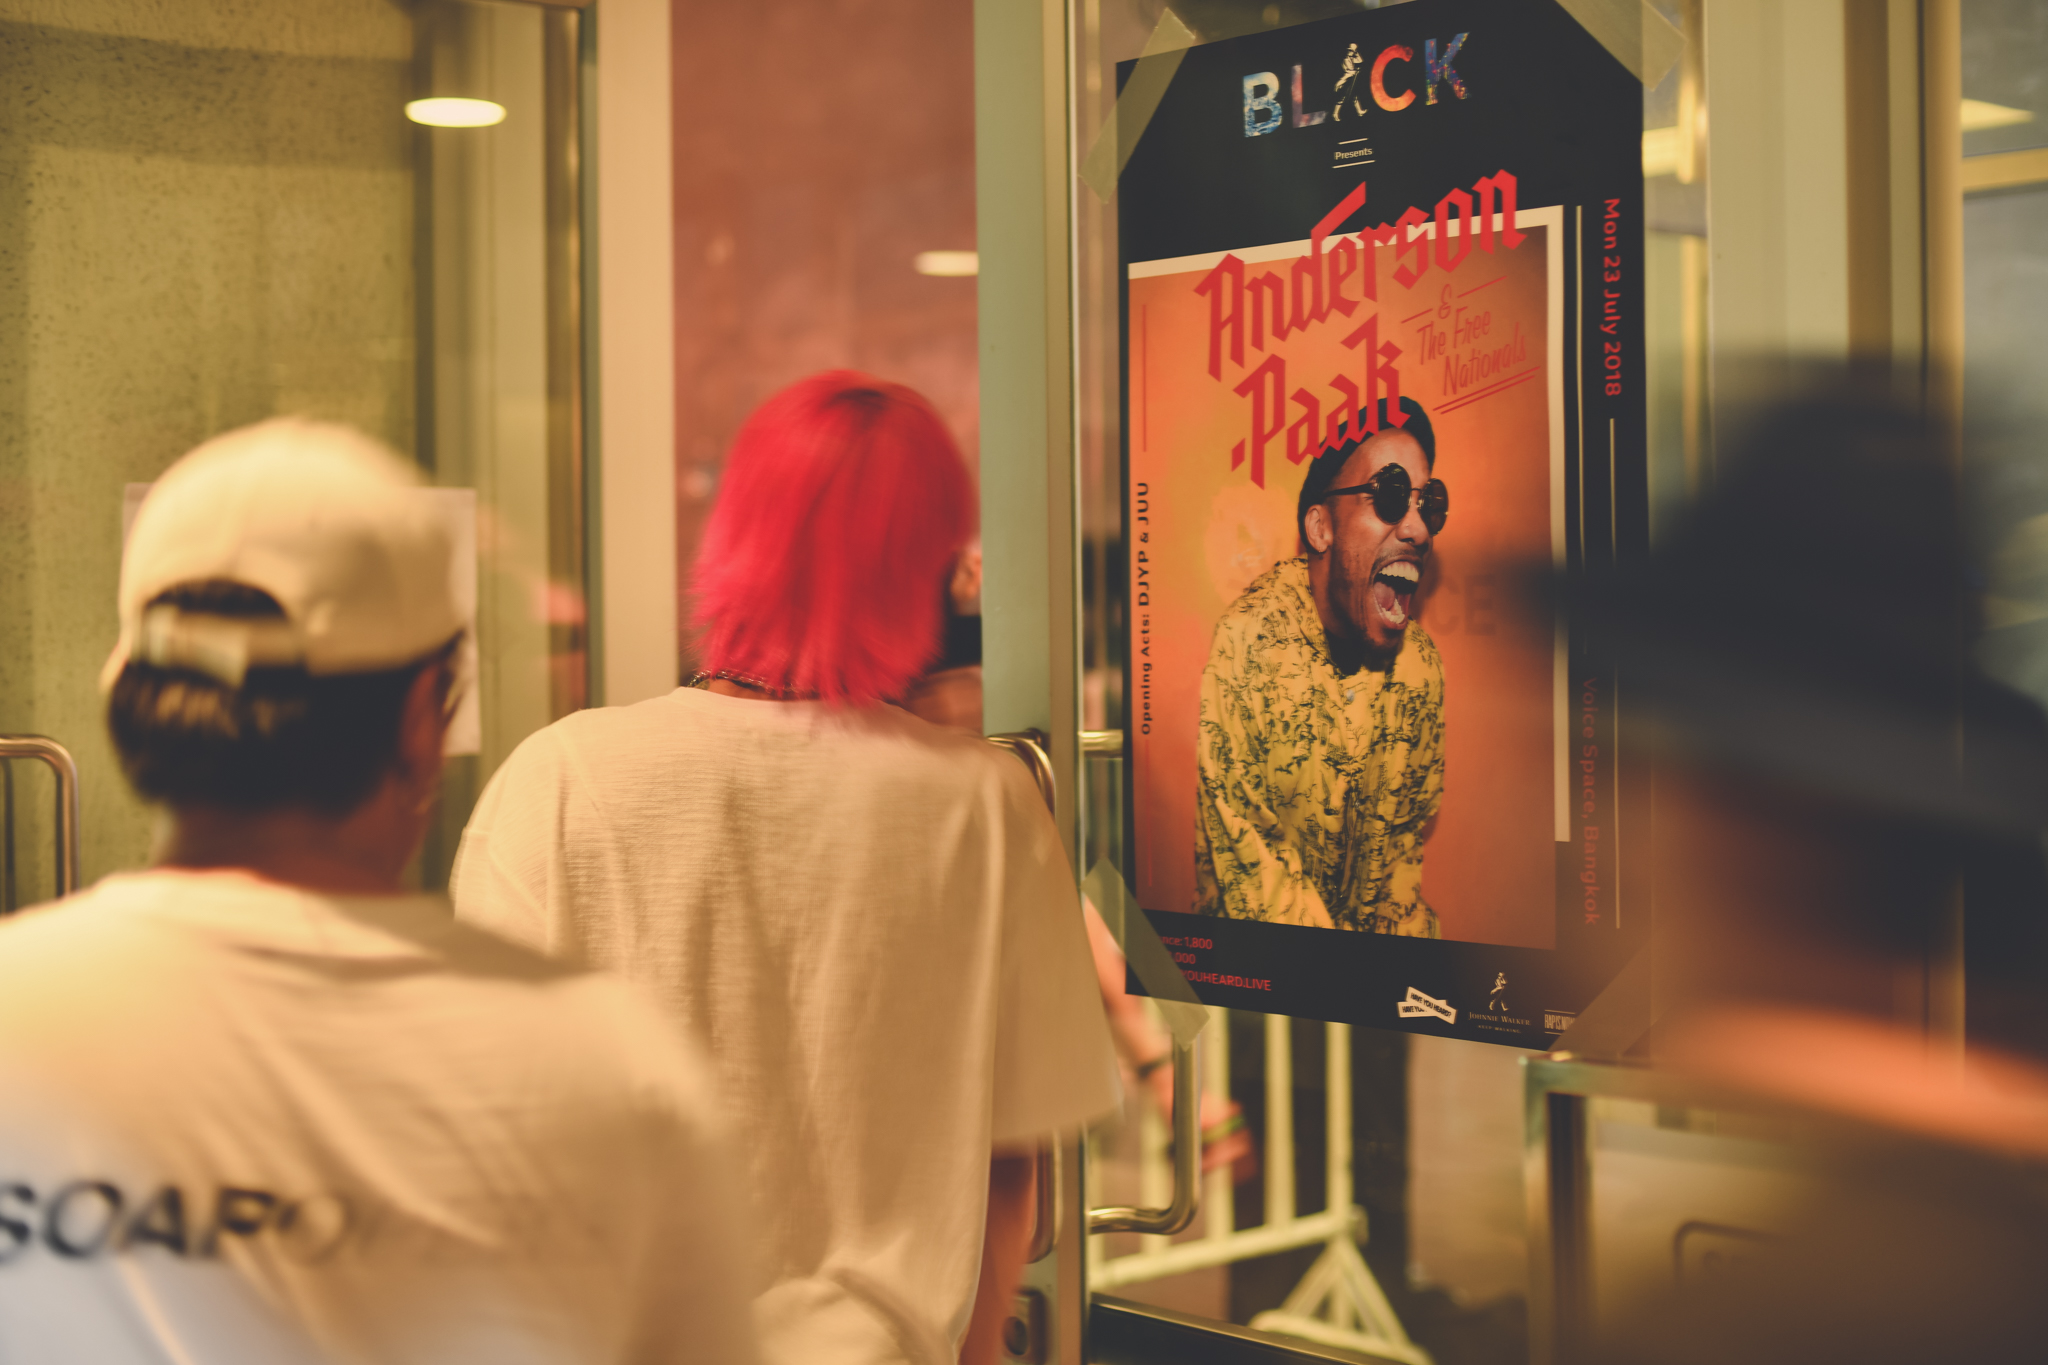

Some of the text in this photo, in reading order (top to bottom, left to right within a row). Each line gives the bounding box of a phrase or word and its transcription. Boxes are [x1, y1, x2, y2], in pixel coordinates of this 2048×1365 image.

[1333, 146, 1373, 161] Presents
[1193, 169, 1528, 383] Anderson
[1600, 198, 1622, 396] Mon 23 July 2018
[1416, 305, 1492, 365] The Free
[1442, 322, 1528, 397] Nationals
[1136, 482, 1149, 526] JUU
[1139, 531, 1149, 544] &
[1140, 613, 1150, 657] Acts:
[1140, 662, 1152, 735] Opening
[1579, 676, 1601, 926] Voice Space, Bangkok
[1160, 936, 1213, 950] nce: 1,800
[1410, 992, 1452, 1018] HAVE YOU HEARD?
